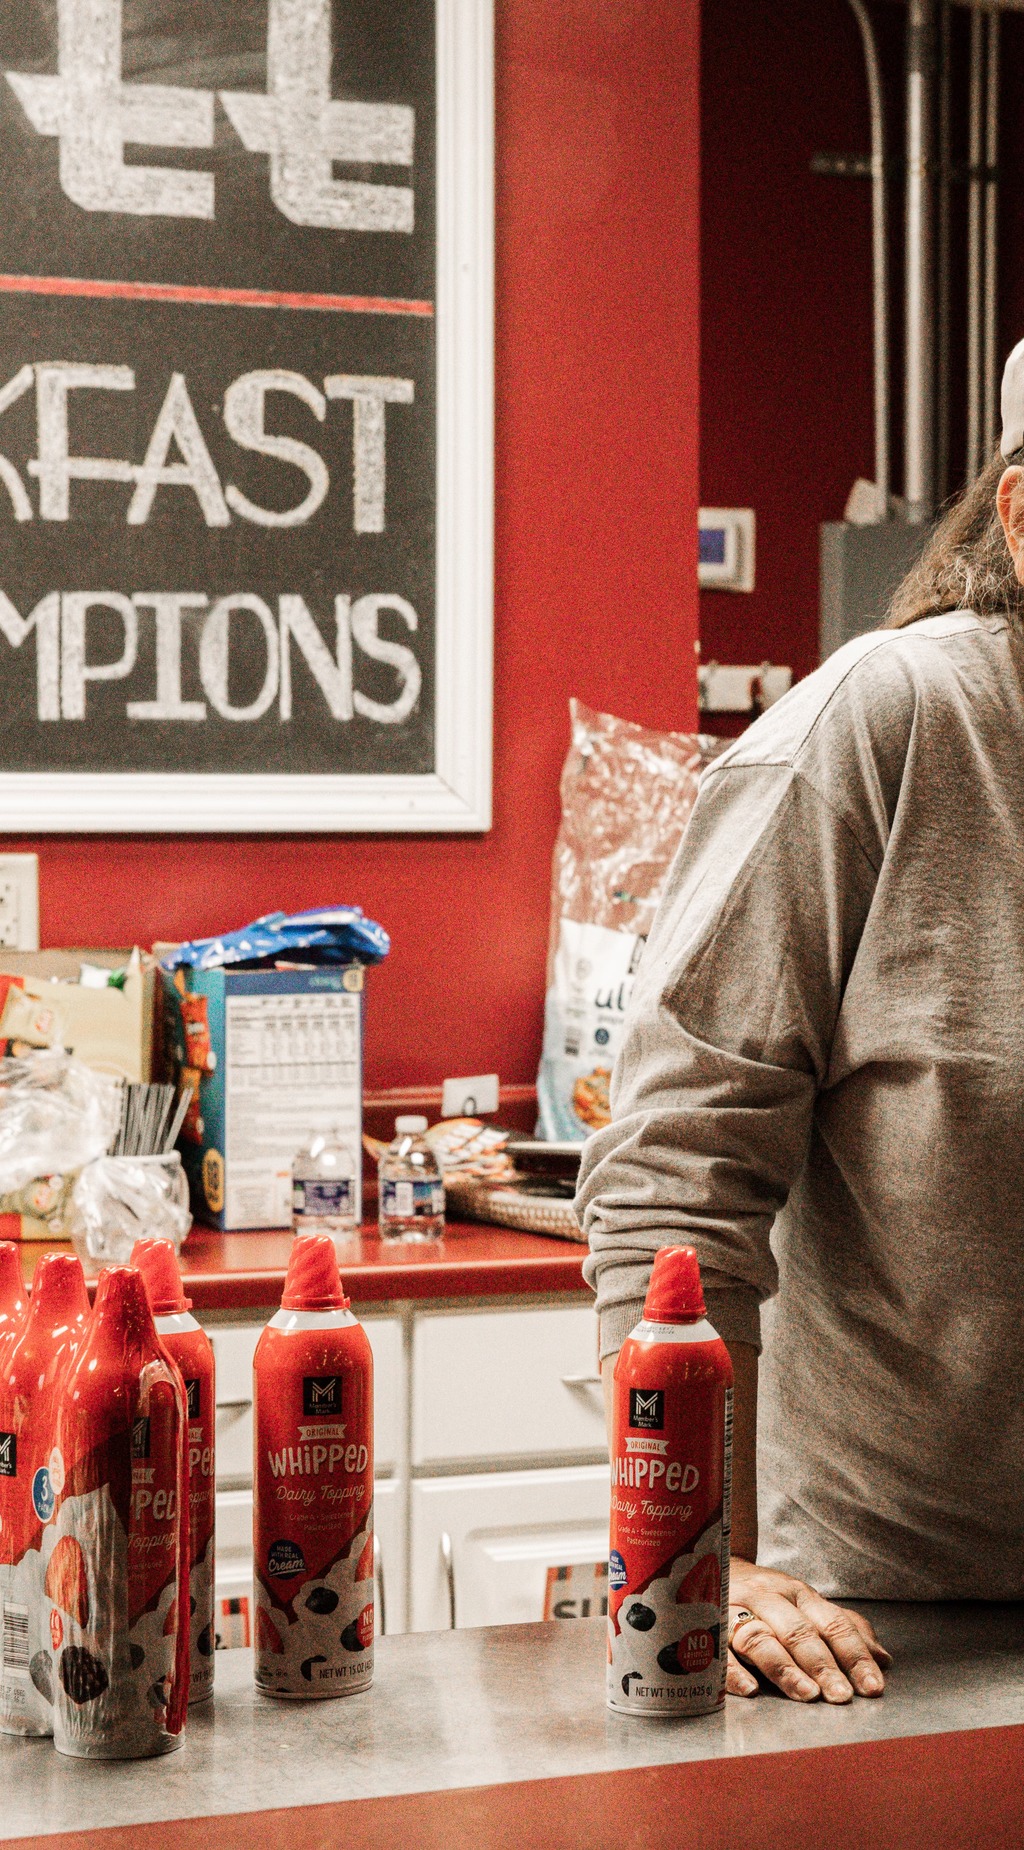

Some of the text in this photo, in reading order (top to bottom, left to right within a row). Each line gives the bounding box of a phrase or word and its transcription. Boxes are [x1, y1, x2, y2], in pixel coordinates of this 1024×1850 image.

[306, 1427, 340, 1437] ORIGINAL
[630, 1440, 661, 1451] ORIGINAL
[41, 1475, 48, 1500] 3
[276, 1484, 366, 1506] Dairy Topping
[611, 1495, 694, 1522] Dairy Topping
[269, 1558, 305, 1572] Cream
[688, 1634, 708, 1650] NO
[319, 1668, 334, 1680] NET
[335, 1667, 347, 1678] WT
[349, 1665, 356, 1676] 15
[635, 1687, 650, 1697] NET
[651, 1687, 663, 1698] WT
[666, 1687, 675, 1698] 15
[677, 1687, 688, 1698] OZ
[690, 1686, 705, 1698] (425
